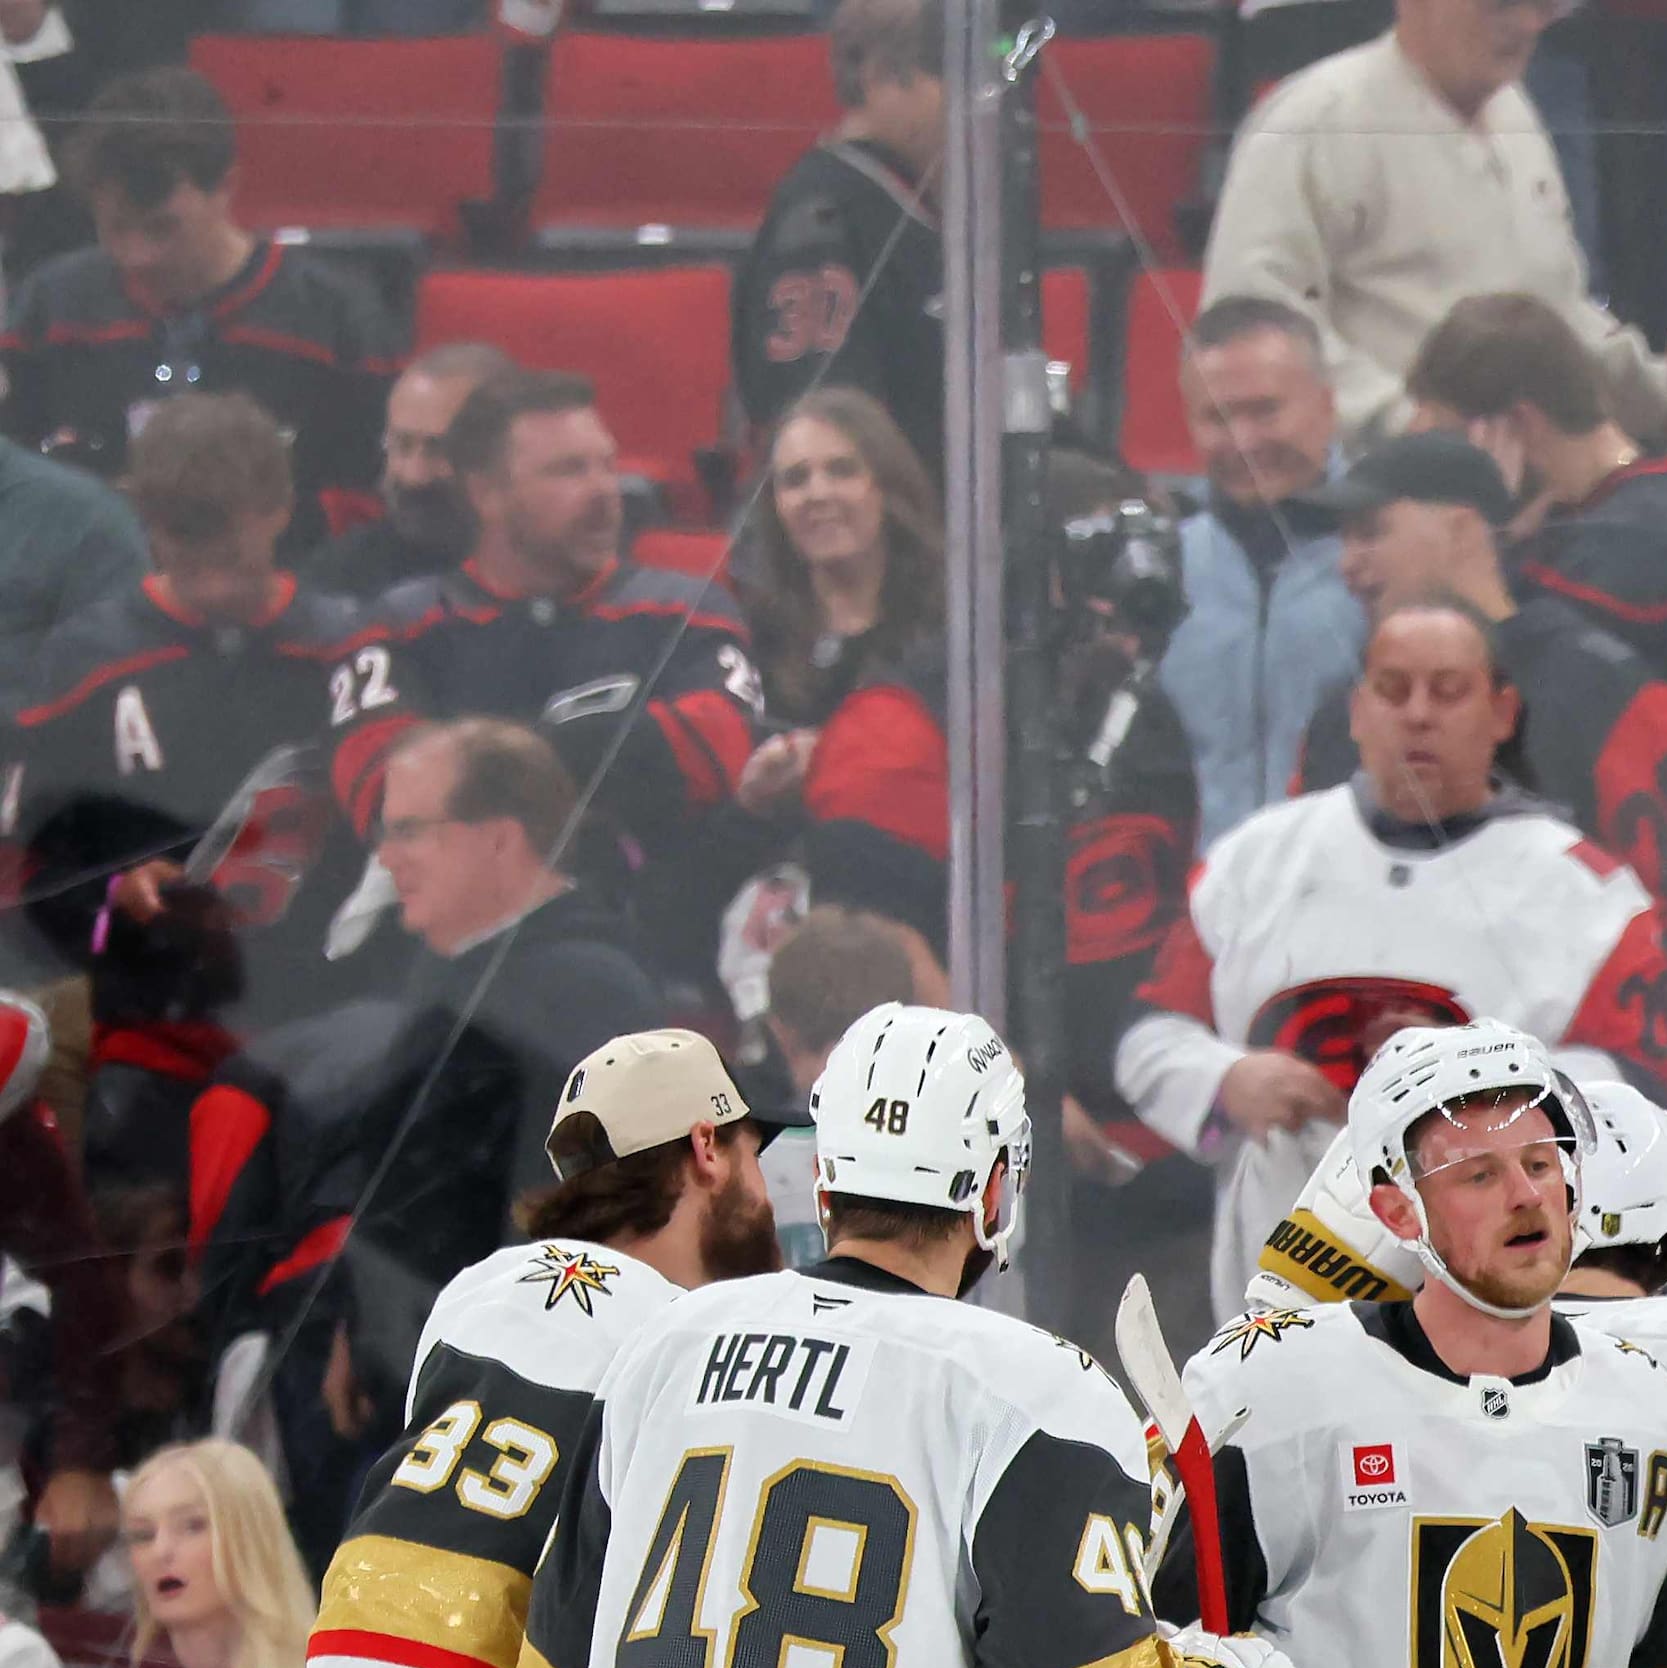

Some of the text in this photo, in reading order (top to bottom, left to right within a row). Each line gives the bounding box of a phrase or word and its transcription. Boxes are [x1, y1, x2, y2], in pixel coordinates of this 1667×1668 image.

[330, 648, 398, 726] 22
[115, 687, 162, 775] A
[1457, 1043, 1516, 1059] BAUER
[711, 1093, 732, 1116] 33
[864, 1098, 910, 1135] 48
[697, 1333, 851, 1421] HERTL
[388, 1401, 558, 1520] 33
[1348, 1491, 1407, 1506] TOYOTA
